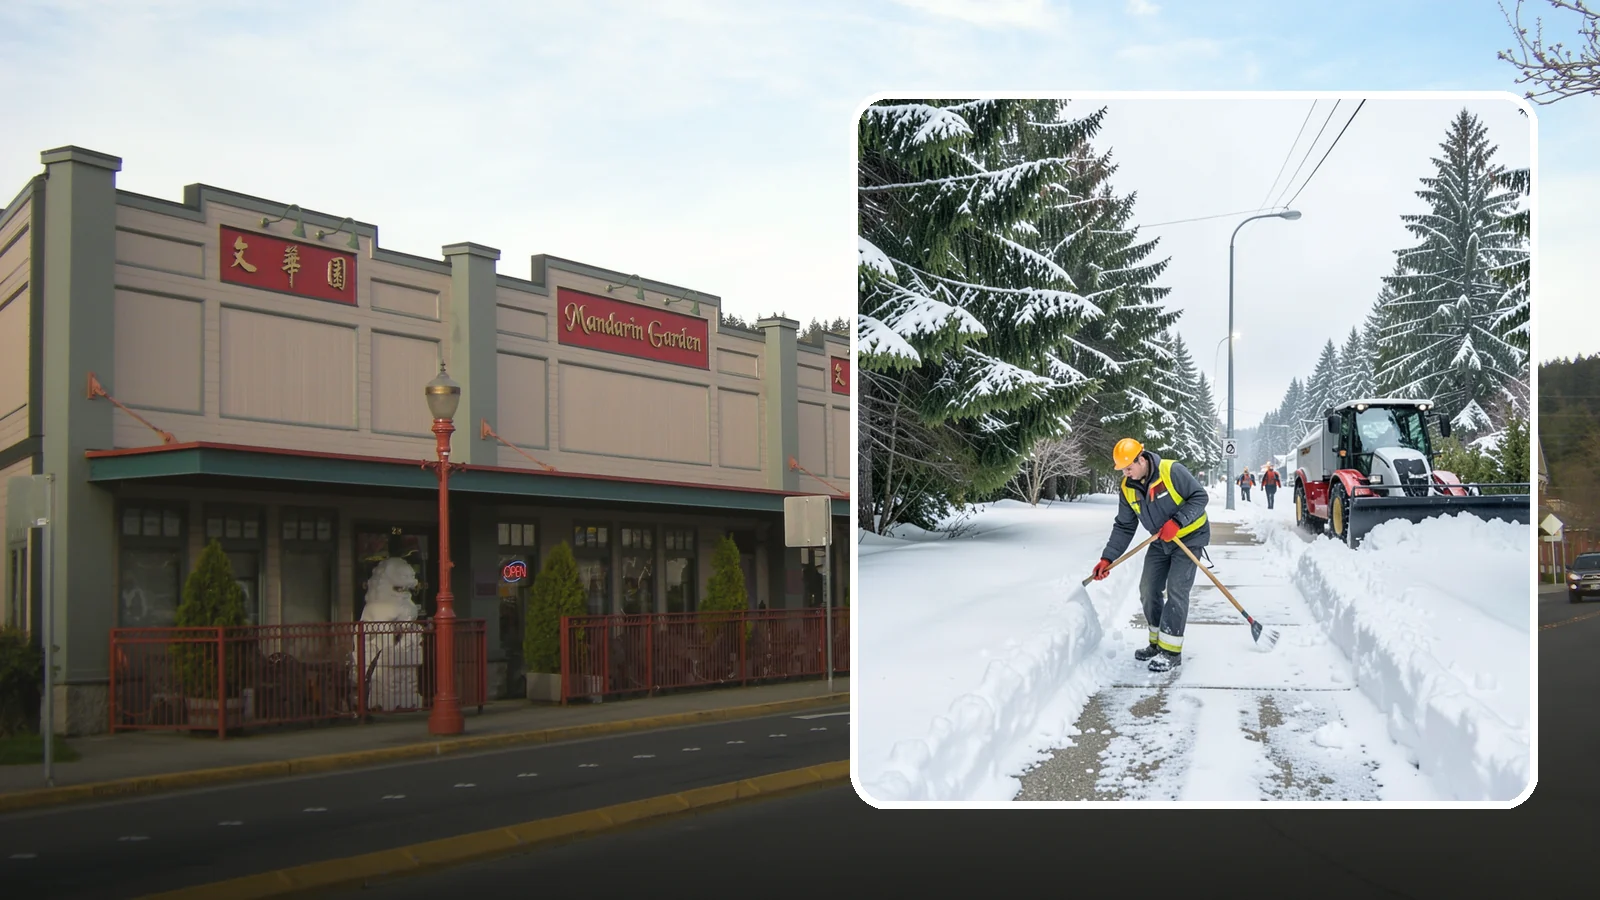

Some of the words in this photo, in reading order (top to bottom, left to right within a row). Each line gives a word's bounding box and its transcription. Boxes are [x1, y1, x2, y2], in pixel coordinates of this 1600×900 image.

[230, 236, 346, 291] 文華園
[565, 302, 643, 341] Mandarin
[648, 320, 701, 352] Garden
[503, 565, 527, 578] OPEN
